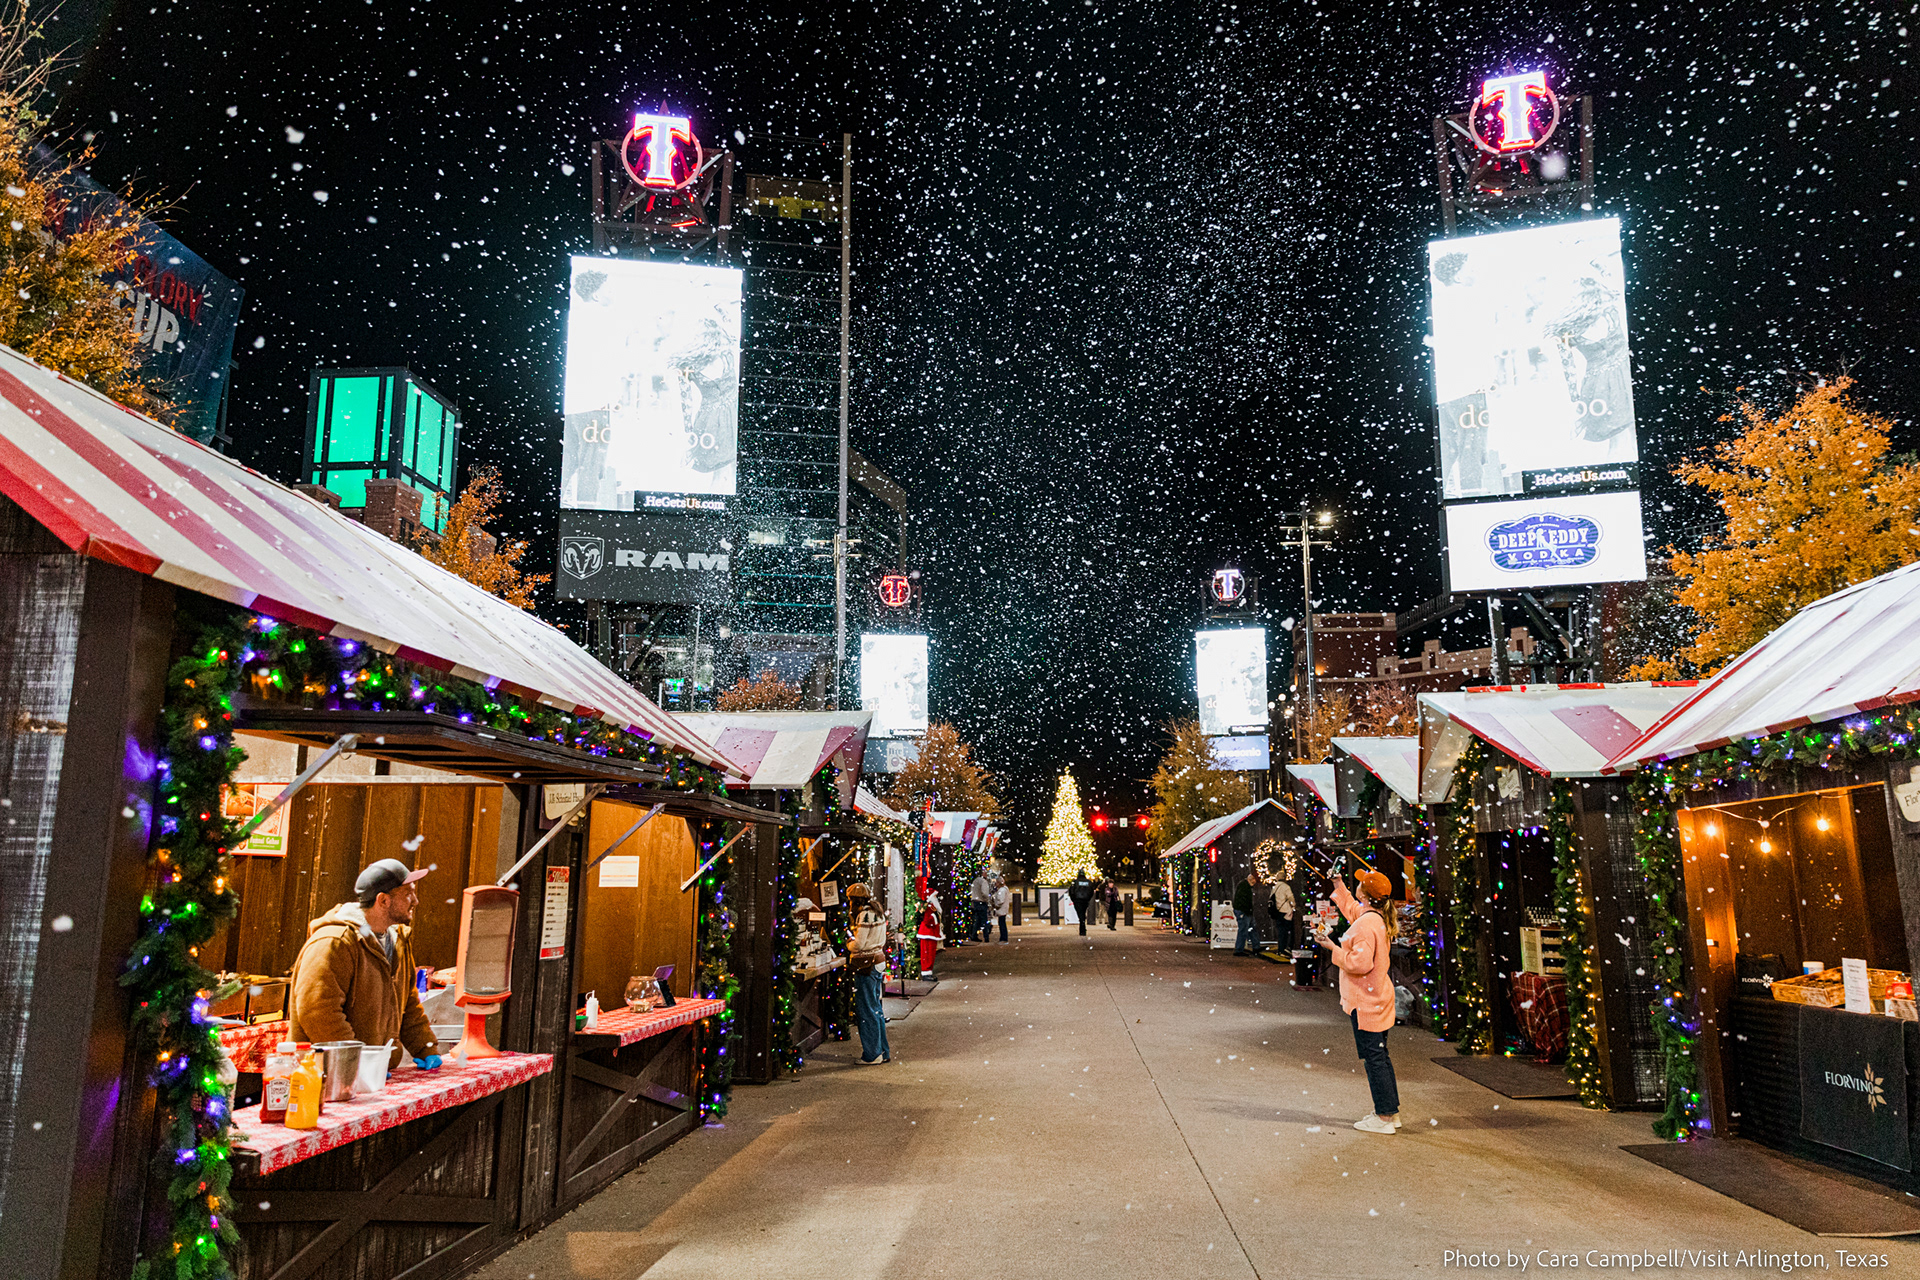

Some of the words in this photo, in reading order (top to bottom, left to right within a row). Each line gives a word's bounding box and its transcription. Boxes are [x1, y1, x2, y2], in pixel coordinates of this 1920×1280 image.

[1534, 469, 1628, 486] HeGetsUs.com
[644, 496, 725, 510] HeGetsUs.com
[1498, 532, 1537, 549] DEEP
[1548, 527, 1589, 544] EDDY
[615, 550, 729, 571] RAM
[1824, 1071, 1874, 1095] FLORVINO
